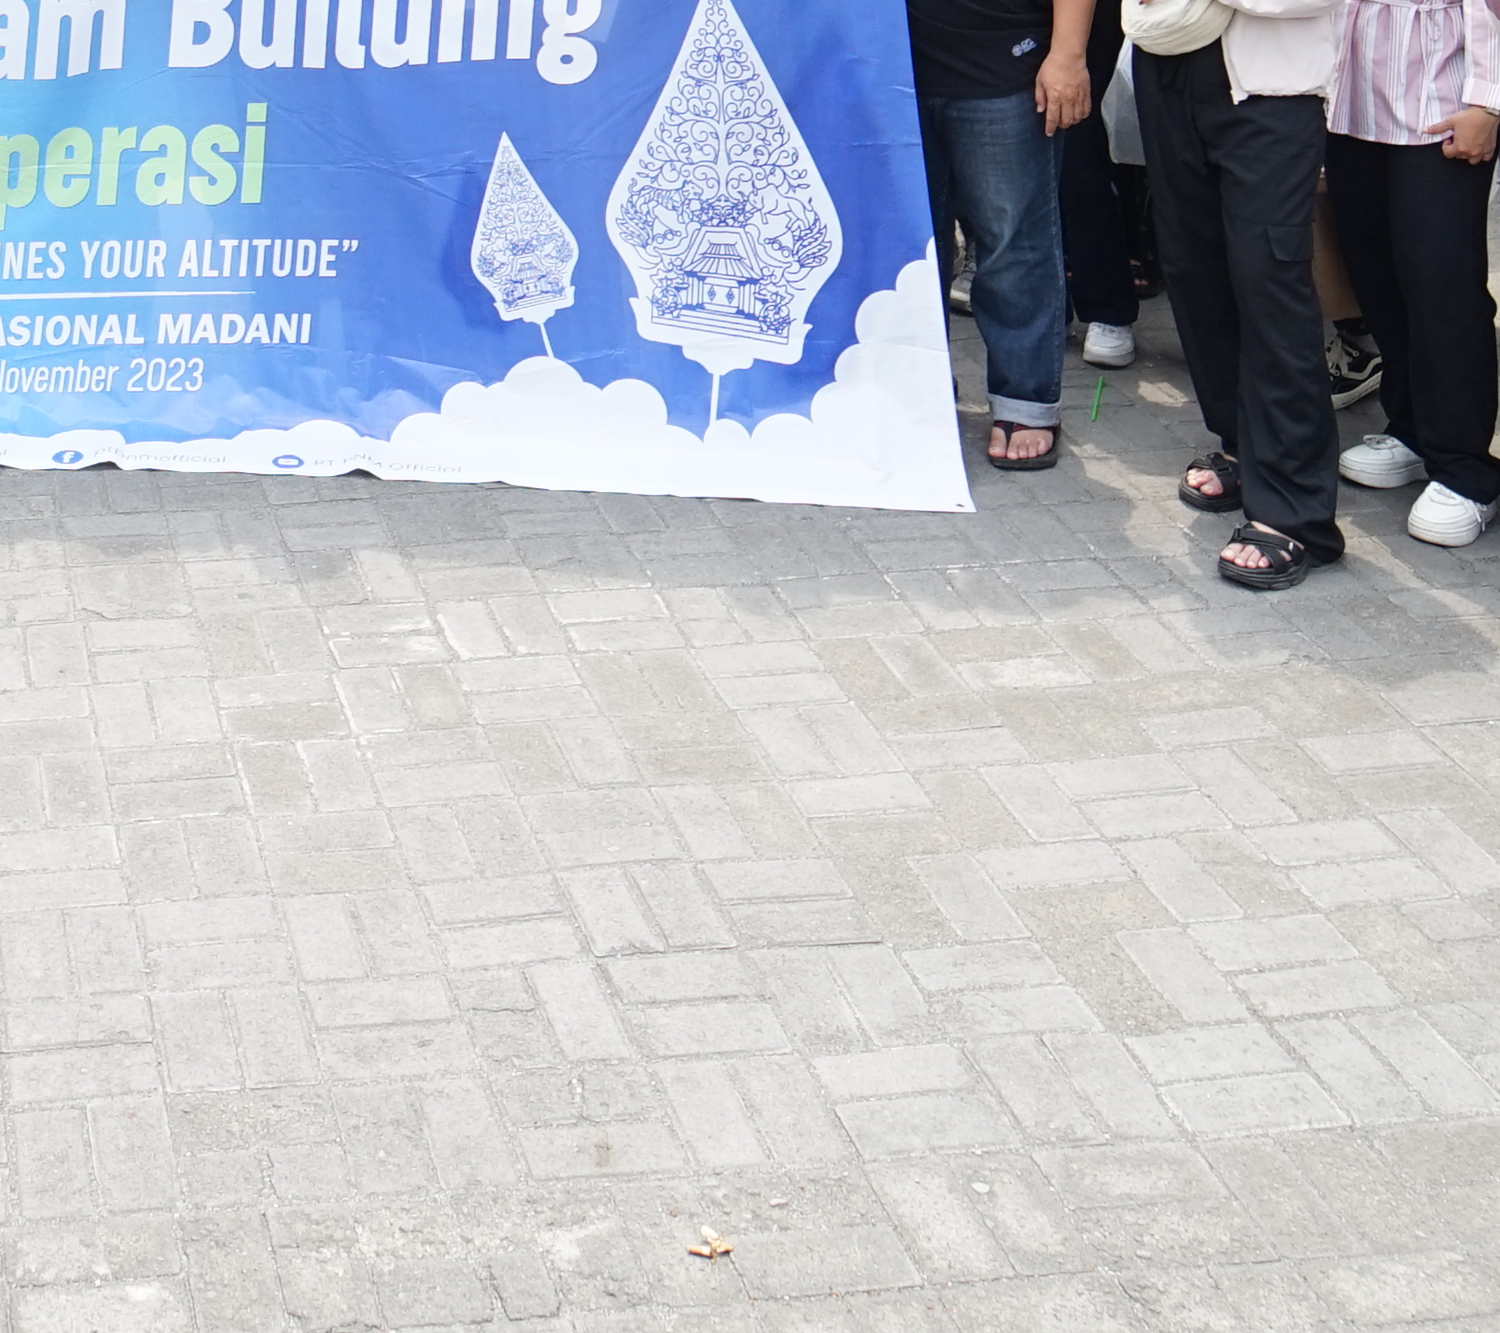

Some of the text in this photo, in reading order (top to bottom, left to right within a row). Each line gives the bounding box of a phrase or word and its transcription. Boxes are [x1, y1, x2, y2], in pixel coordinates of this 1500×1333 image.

[80, 239, 168, 280] YOUR
[156, 312, 312, 346] MADANI
[126, 357, 205, 394] 2023
